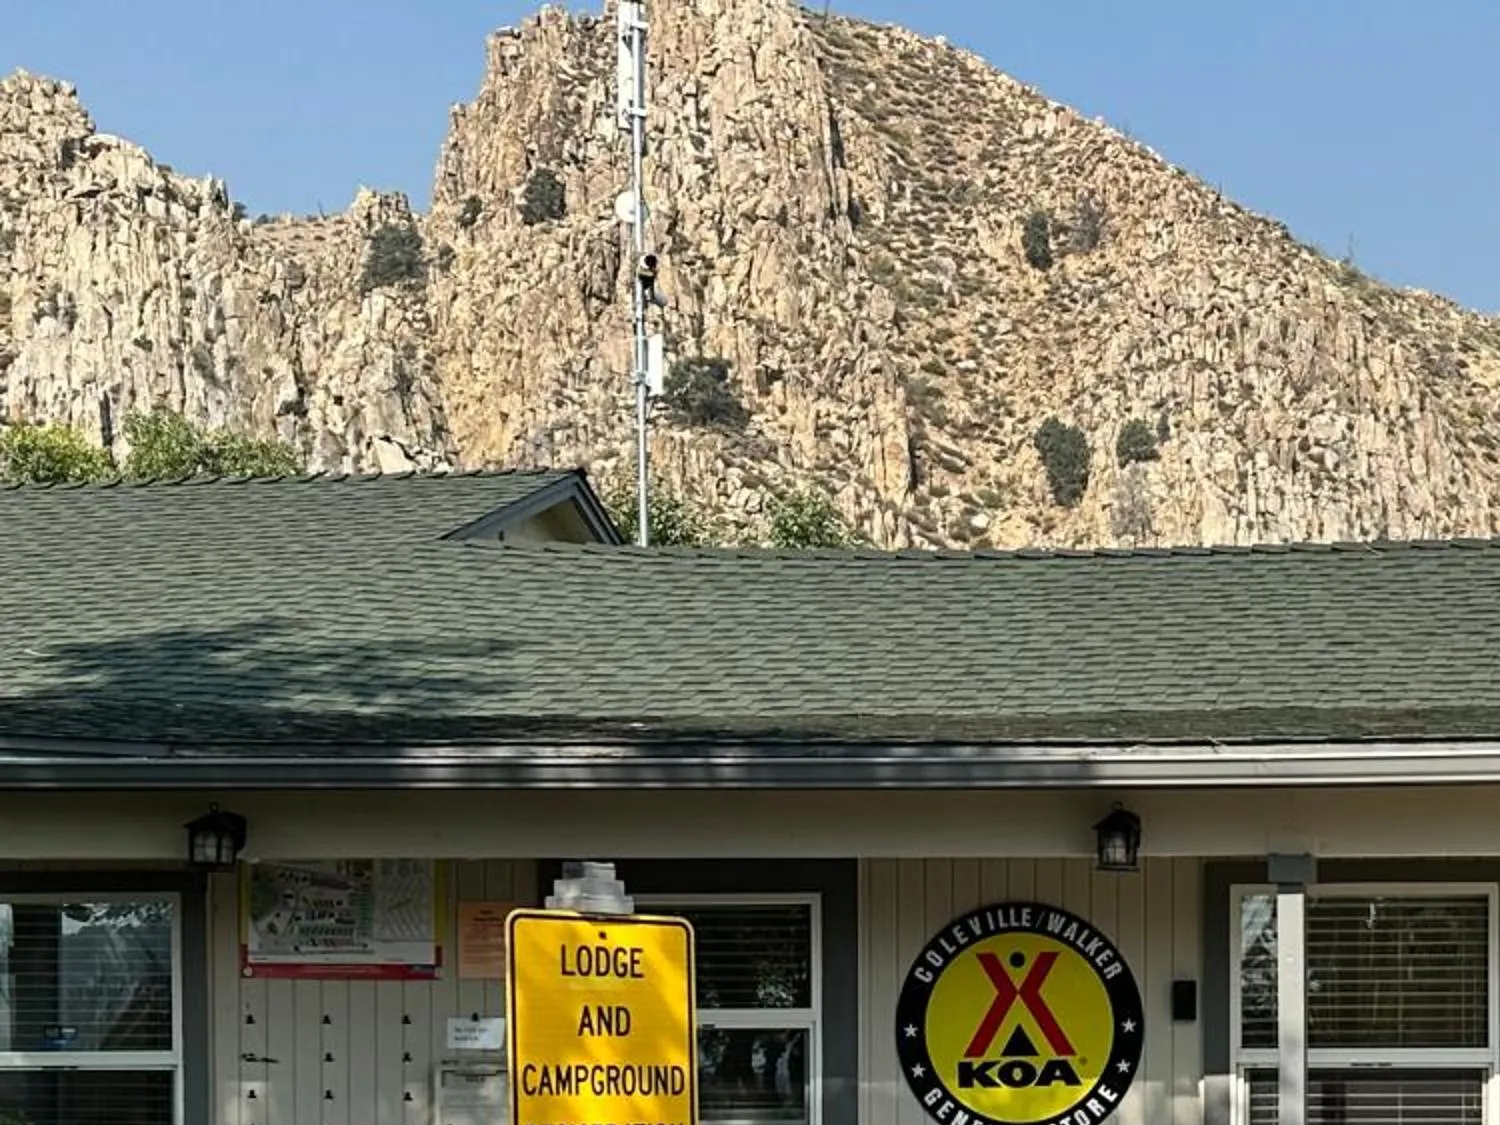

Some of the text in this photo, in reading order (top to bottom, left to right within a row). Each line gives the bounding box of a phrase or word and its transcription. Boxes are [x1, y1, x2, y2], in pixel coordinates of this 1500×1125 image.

[561, 944, 645, 979] LODGE
[577, 1005, 631, 1037] AND
[522, 1063, 686, 1097] CAMPGROUND
[958, 1059, 1083, 1089] KOA
